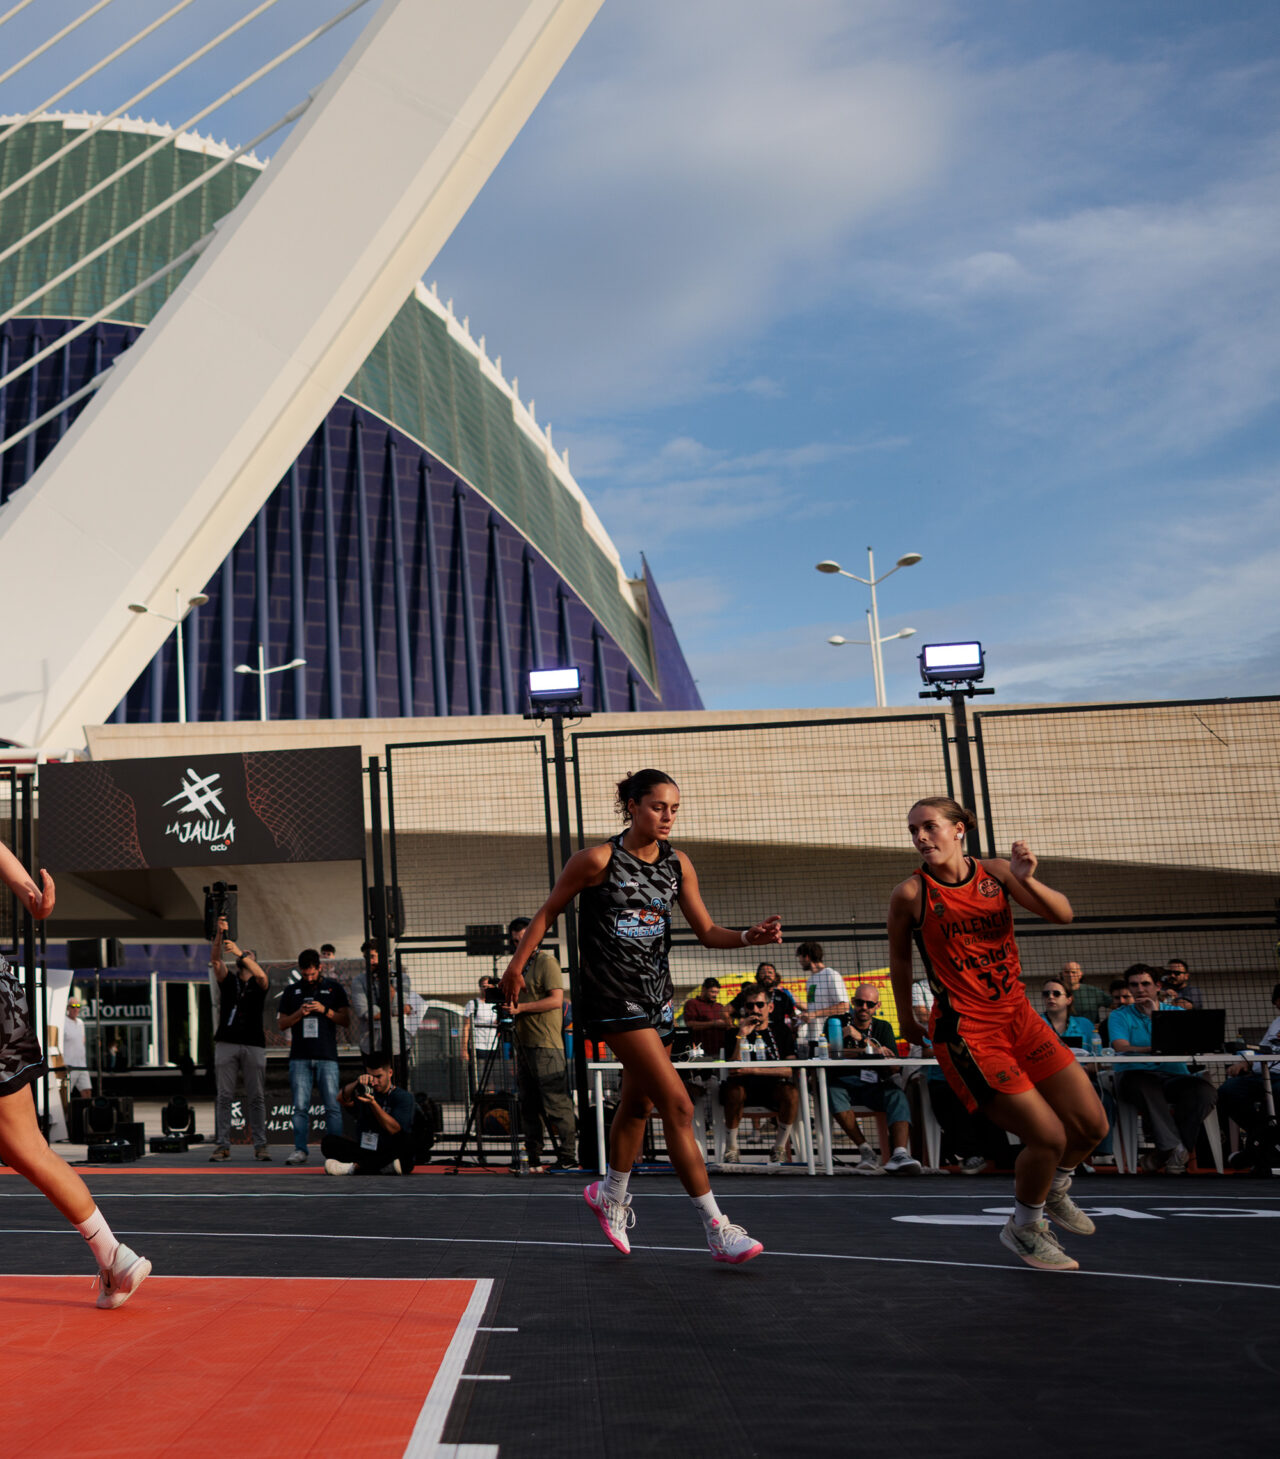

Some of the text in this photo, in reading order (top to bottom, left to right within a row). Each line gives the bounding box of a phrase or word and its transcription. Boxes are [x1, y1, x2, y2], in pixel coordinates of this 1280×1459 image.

[165, 818, 236, 845] LA JAULA
[977, 965, 1013, 1001] 32
